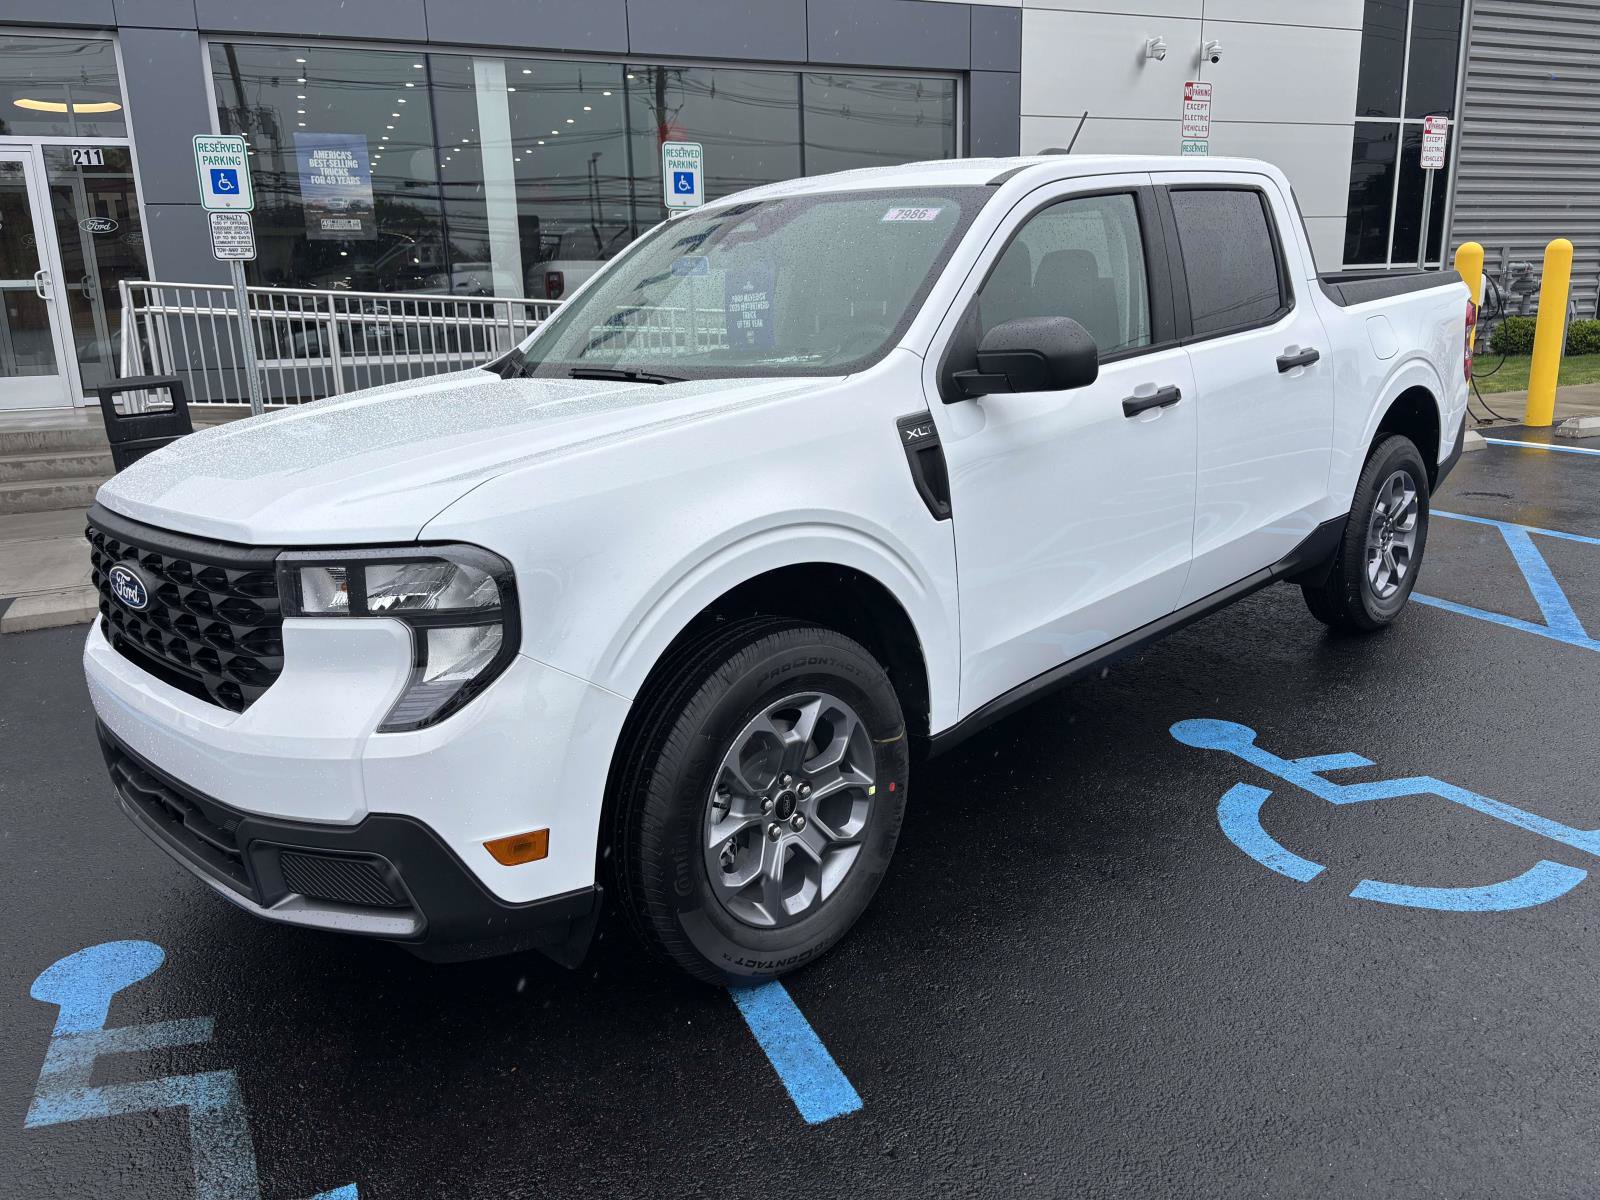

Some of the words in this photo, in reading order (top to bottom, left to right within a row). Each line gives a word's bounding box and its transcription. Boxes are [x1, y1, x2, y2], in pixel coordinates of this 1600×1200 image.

[1185, 86, 1192, 97] NO
[1184, 124, 1208, 132] VEHICLES
[198, 142, 242, 153] RESERVED
[1183, 144, 1207, 152] RESERVED
[73, 149, 103, 165] 211
[313, 149, 352, 159] AMERICA'S
[666, 148, 699, 159] RESERVED
[202, 155, 241, 166] PARKING
[309, 158, 358, 168] BEST-SELLING
[668, 160, 698, 169] PARKING
[319, 167, 349, 176] TRUCKS
[310, 175, 326, 184] FOR
[326, 176, 336, 184] 49
[337, 176, 361, 185] YEARS
[894, 209, 928, 219] 7986
[87, 219, 111, 231] Ford
[906, 425, 932, 440] XLT
[116, 571, 140, 604] Ford
